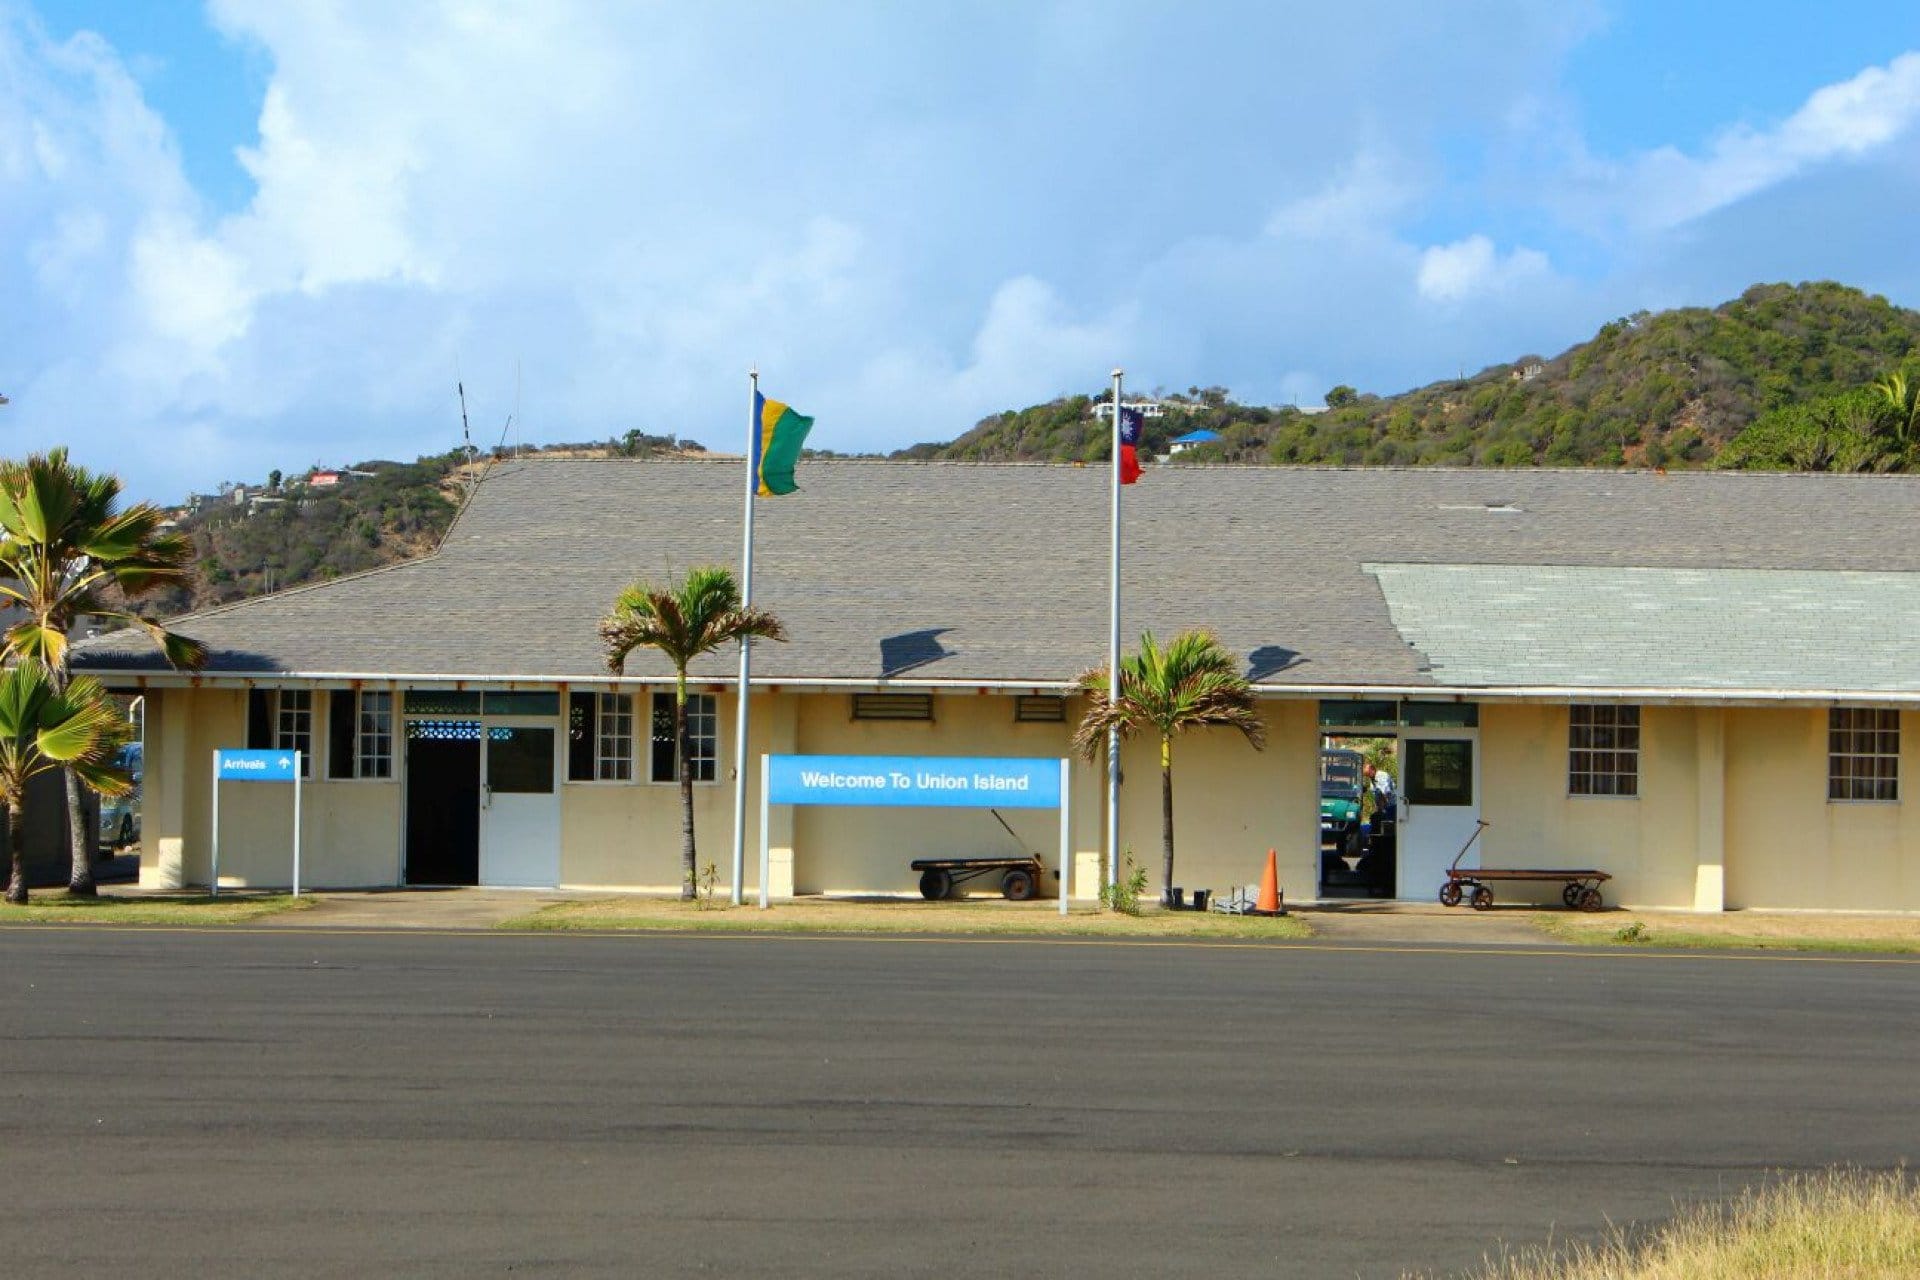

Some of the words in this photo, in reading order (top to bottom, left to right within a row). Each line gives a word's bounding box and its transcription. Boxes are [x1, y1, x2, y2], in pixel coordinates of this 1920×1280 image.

[223, 758, 267, 770] Arrivals
[801, 771, 887, 789] Welcome
[888, 771, 912, 789] To
[916, 772, 968, 790] Union
[973, 773, 1029, 791] Island
